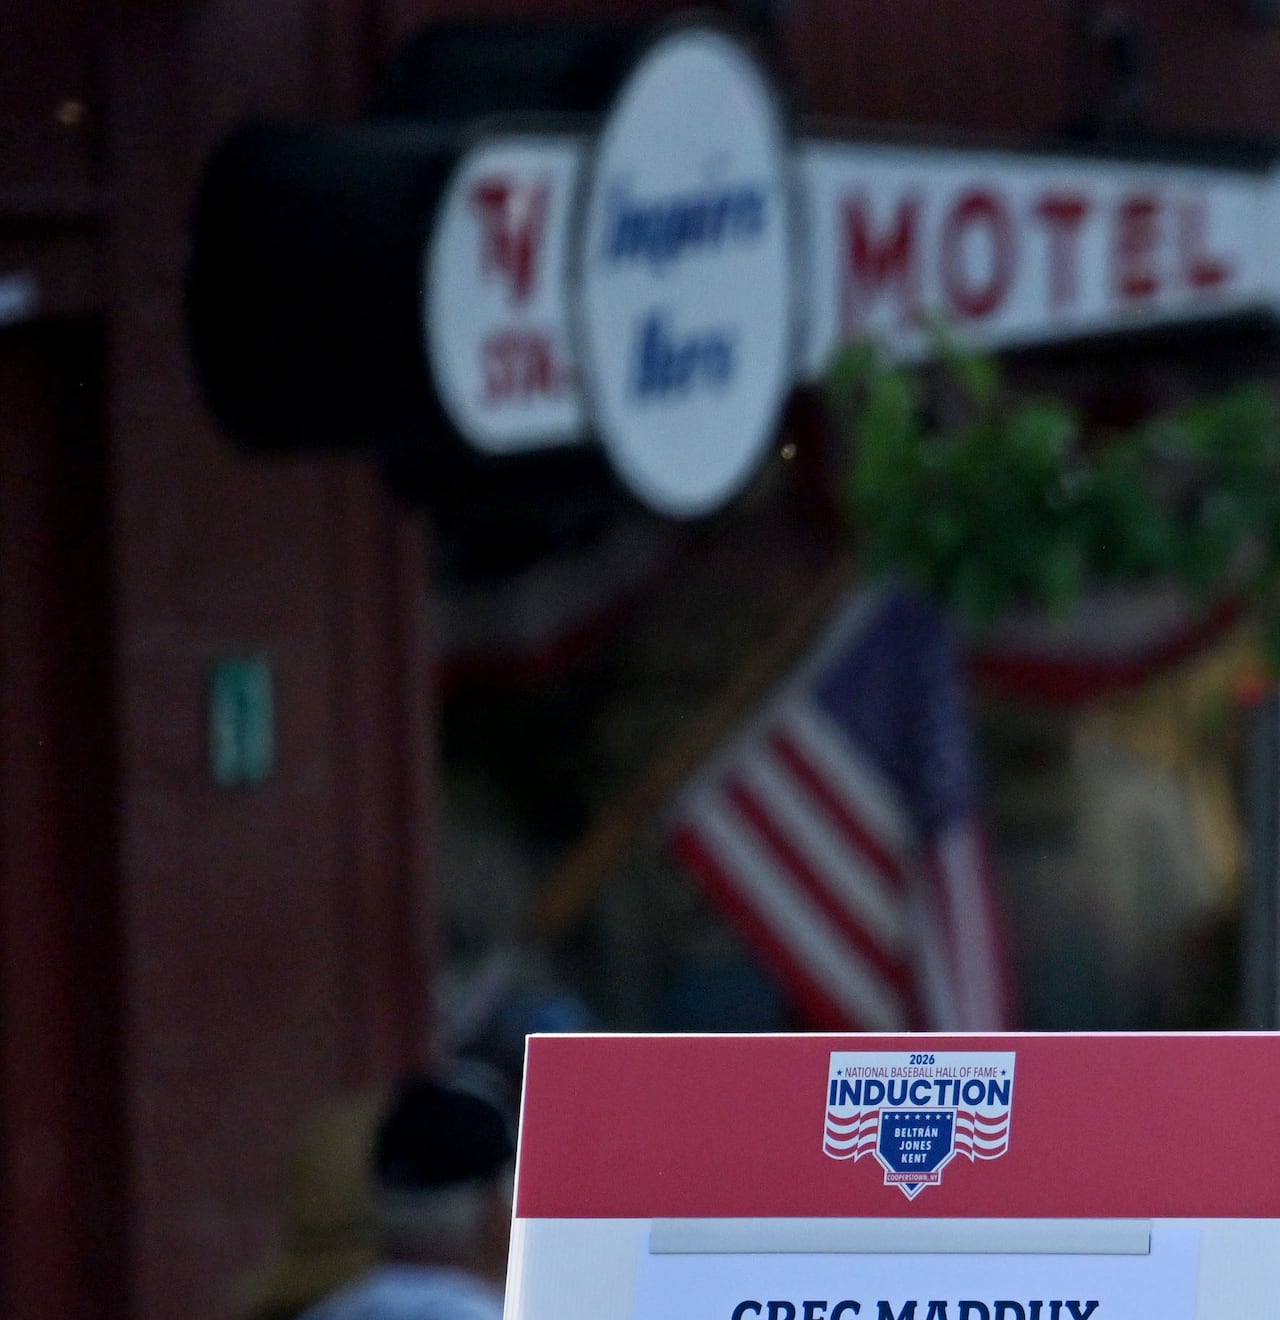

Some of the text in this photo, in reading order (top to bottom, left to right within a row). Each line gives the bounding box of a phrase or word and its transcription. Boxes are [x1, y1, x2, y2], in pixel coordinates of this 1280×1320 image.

[470, 174, 555, 306] TV
[838, 184, 1233, 338] MOTEL
[909, 1054, 935, 1065] 2026
[845, 1066, 998, 1078] NATIONAL BASEBALL HALL OF FAME
[829, 1079, 1011, 1106] INDUCTION
[894, 1125, 939, 1138] BELTRÁN
[899, 1140, 932, 1151] JONES
[901, 1153, 927, 1164] KENT
